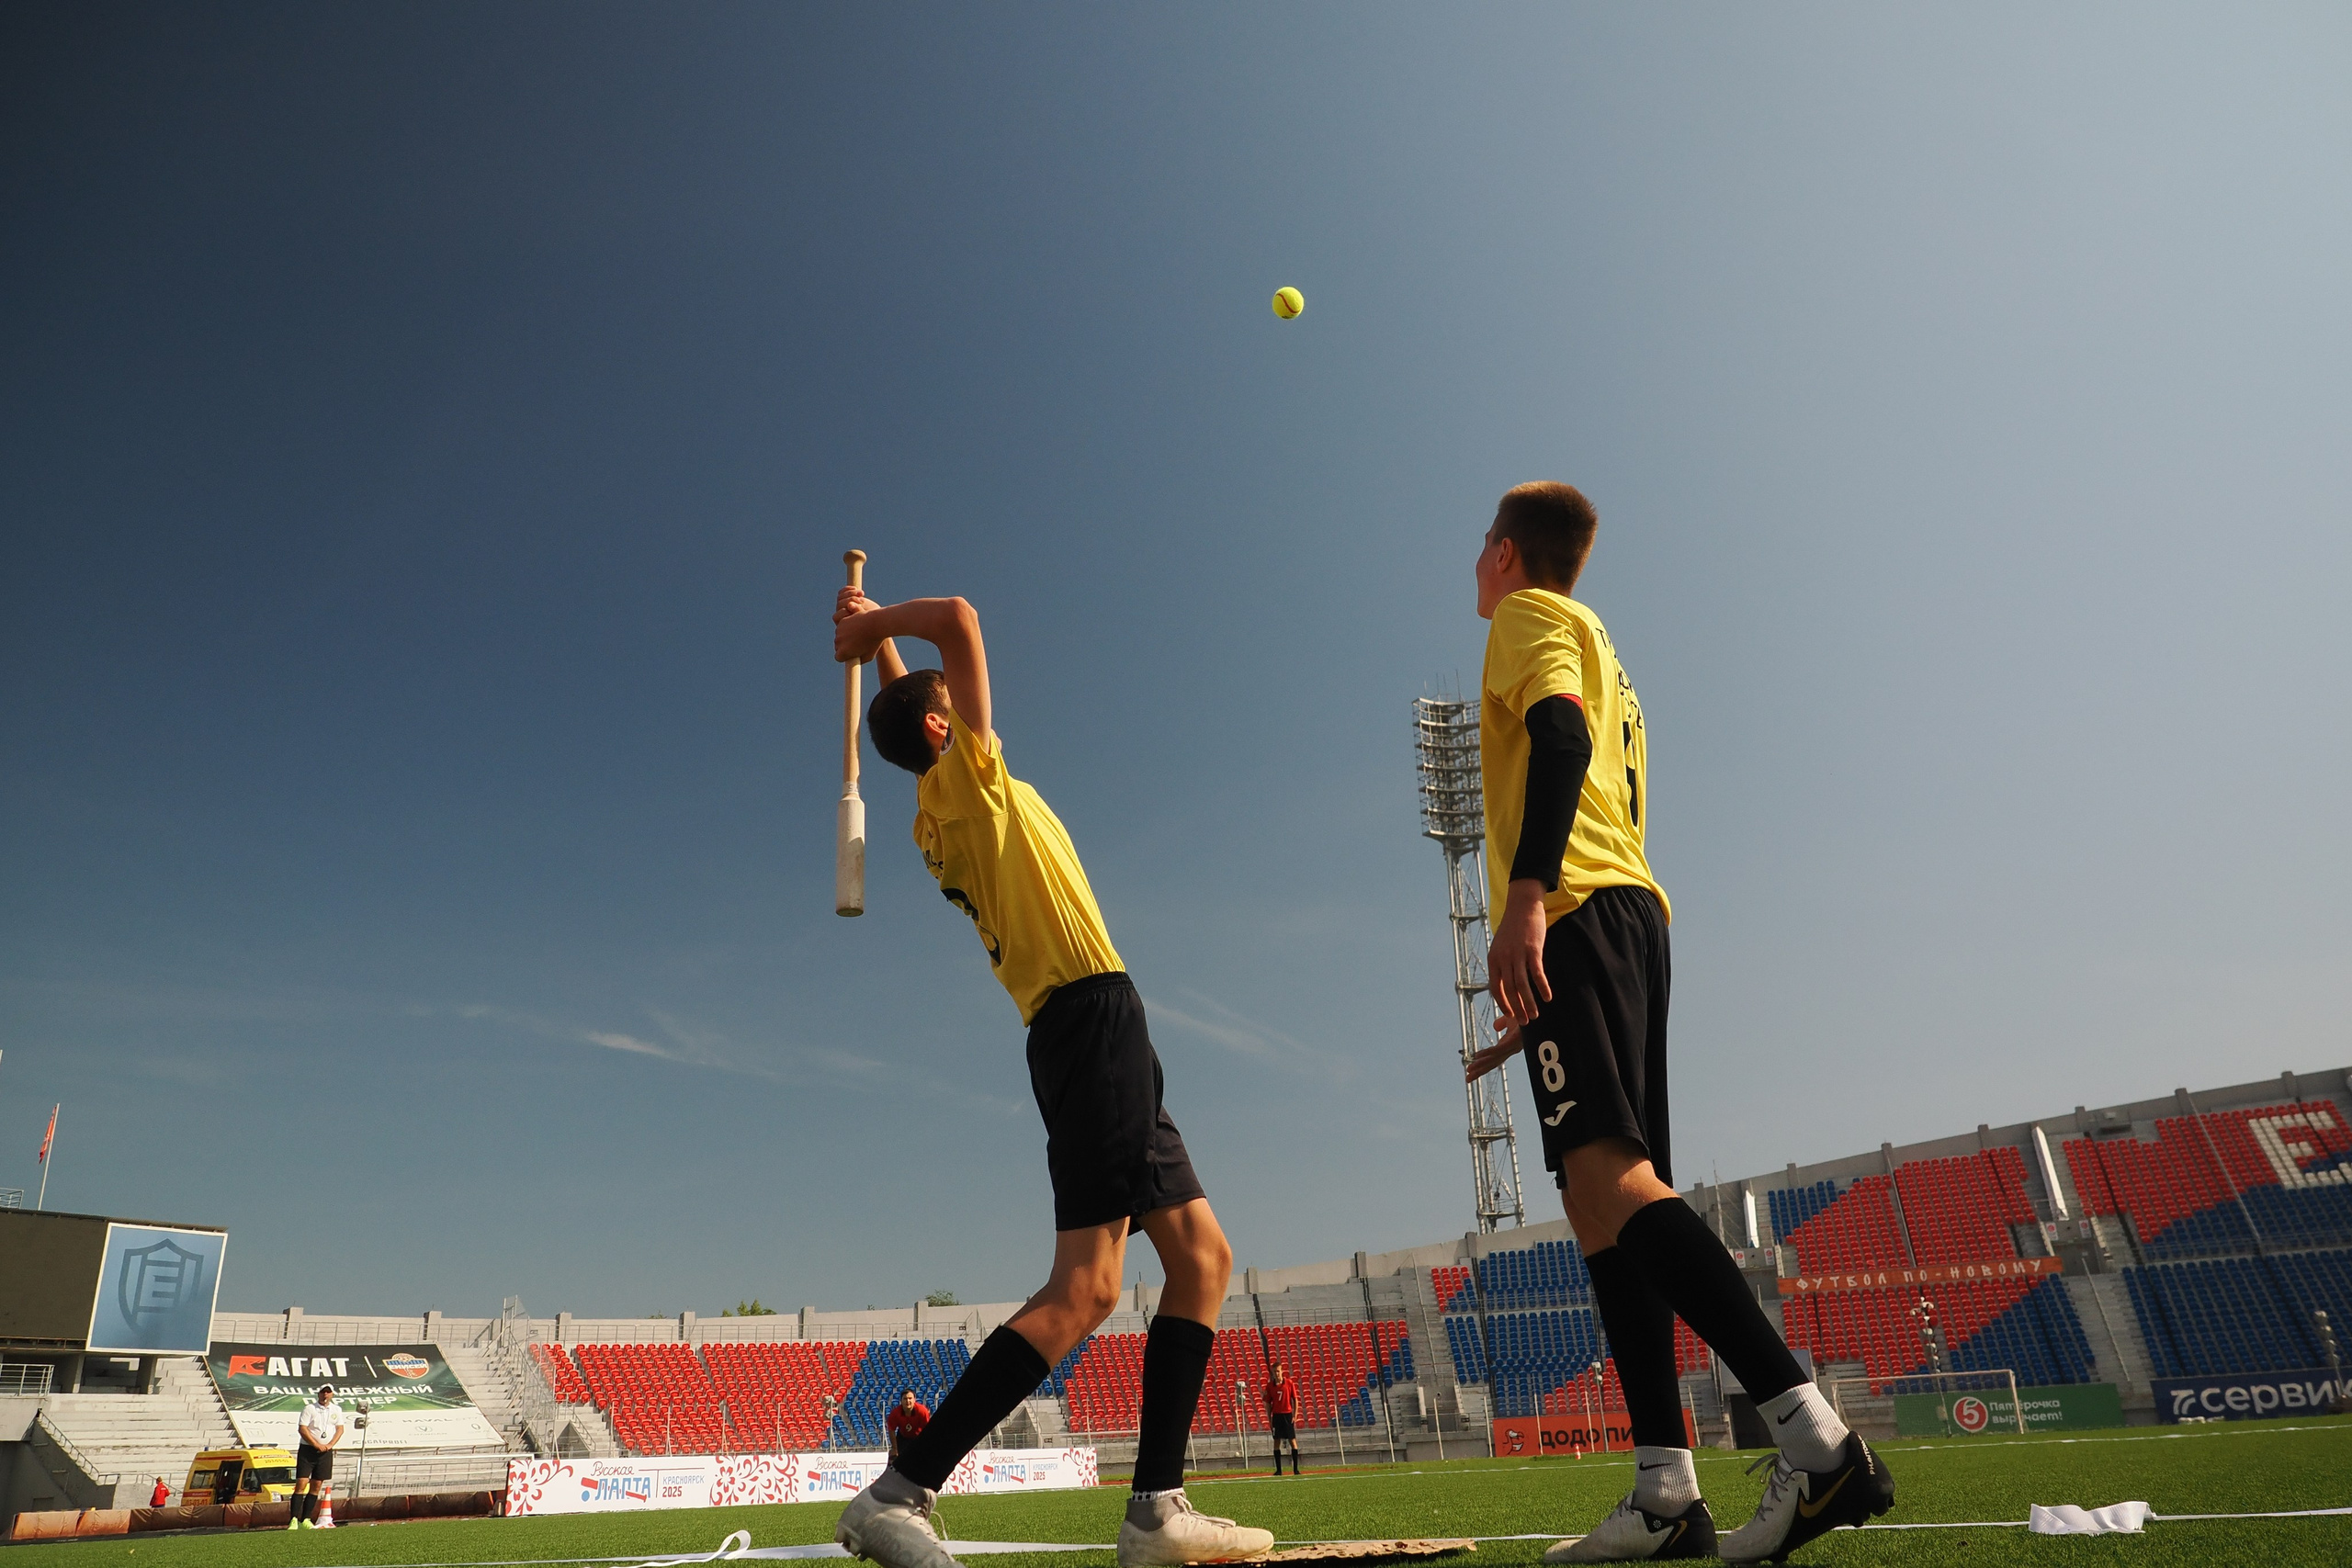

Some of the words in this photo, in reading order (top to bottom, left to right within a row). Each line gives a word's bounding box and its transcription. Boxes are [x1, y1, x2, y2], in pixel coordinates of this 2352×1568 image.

[1538, 1040, 1566, 1093] 8
[1796, 1273, 1888, 1290] ФУТБОЛ
[267, 1356, 350, 1377] АГАТ
[253, 1385, 303, 1395] ВАШ
[308, 1383, 434, 1396] НДЕЖНЫЙ
[1277, 1391, 1283, 1402] 7
[302, 1396, 398, 1405] ПРТНЕР
[1992, 1411, 2064, 1426] вырчает!
[905, 1423, 912, 1432] 9
[819, 1470, 862, 1491] ЛАПТА
[992, 1464, 1027, 1483] ЛАПТА
[1033, 1472, 1046, 1481] 2025
[594, 1476, 651, 1501] ЛАПТА
[662, 1485, 683, 1497] 2025
